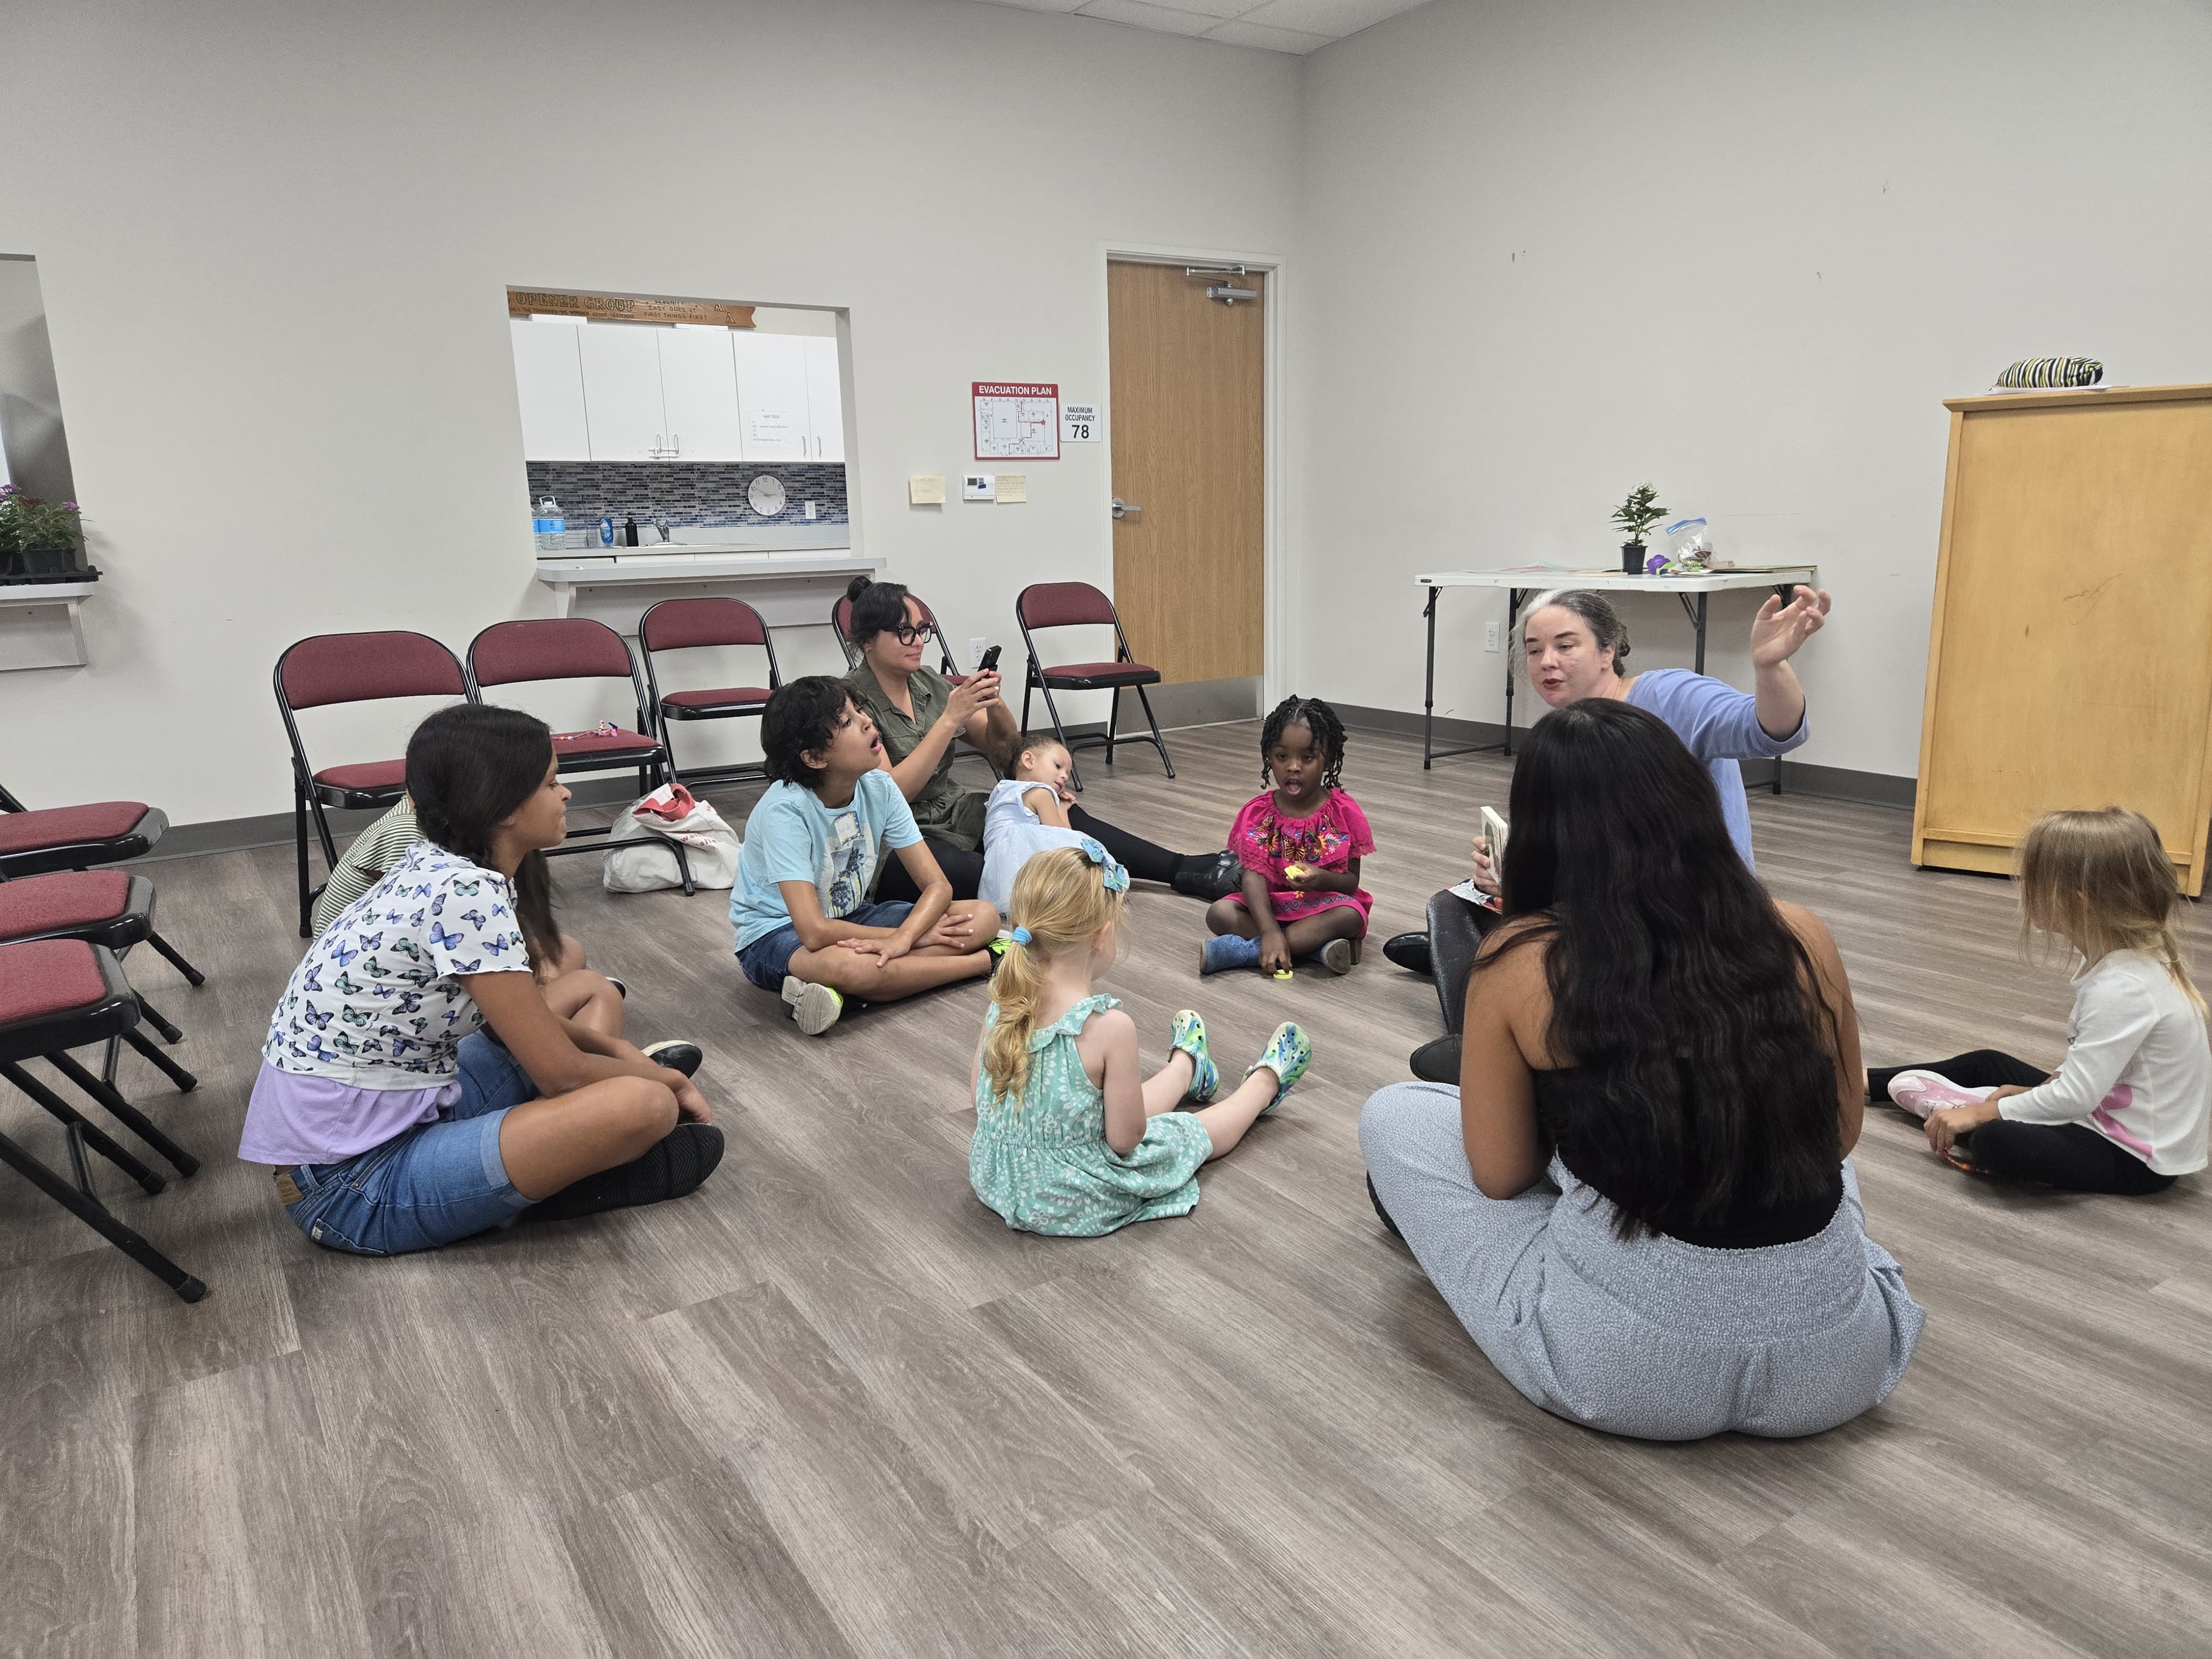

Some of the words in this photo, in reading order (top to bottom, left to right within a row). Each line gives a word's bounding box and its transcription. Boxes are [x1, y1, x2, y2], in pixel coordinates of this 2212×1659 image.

[516, 292, 579, 308] OPENER
[583, 296, 635, 312] GROUP
[979, 385, 1030, 394] EVACUATION
[1032, 387, 1052, 395] PLAN
[1072, 425, 1089, 439] 78
